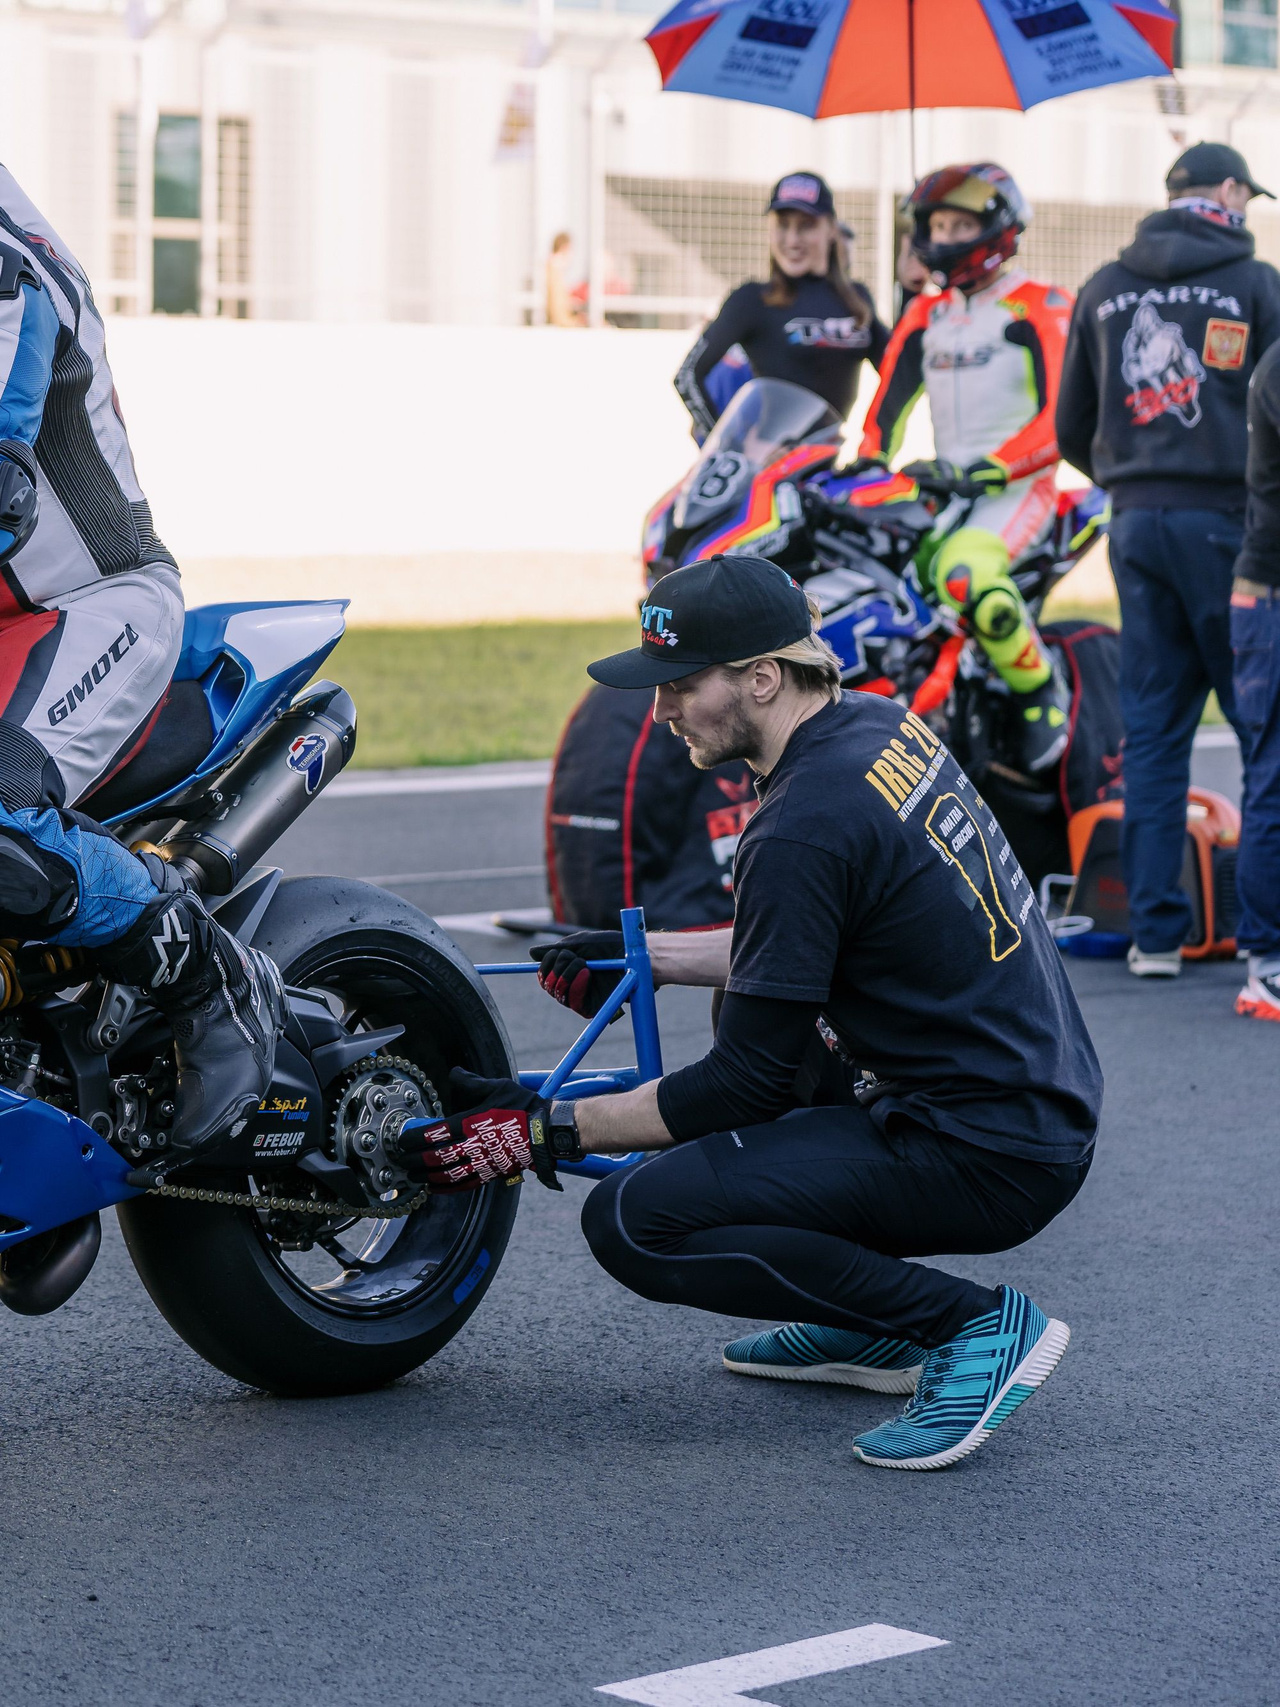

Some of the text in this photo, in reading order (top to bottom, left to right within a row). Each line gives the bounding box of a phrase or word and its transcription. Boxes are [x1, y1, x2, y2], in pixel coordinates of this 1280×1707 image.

[1096, 286, 1241, 322] SPARTA
[298, 741, 324, 769] TERMIGNONI
[864, 738, 927, 812] IRRC
[897, 774, 933, 823] INTERNATIONAL
[938, 805, 965, 838] IMATRA
[951, 820, 976, 853] CIRCUIT
[255, 1148, 298, 1157] www.febur.it
[263, 1132, 305, 1148] FEBUR
[471, 1117, 514, 1175] Mechanix
